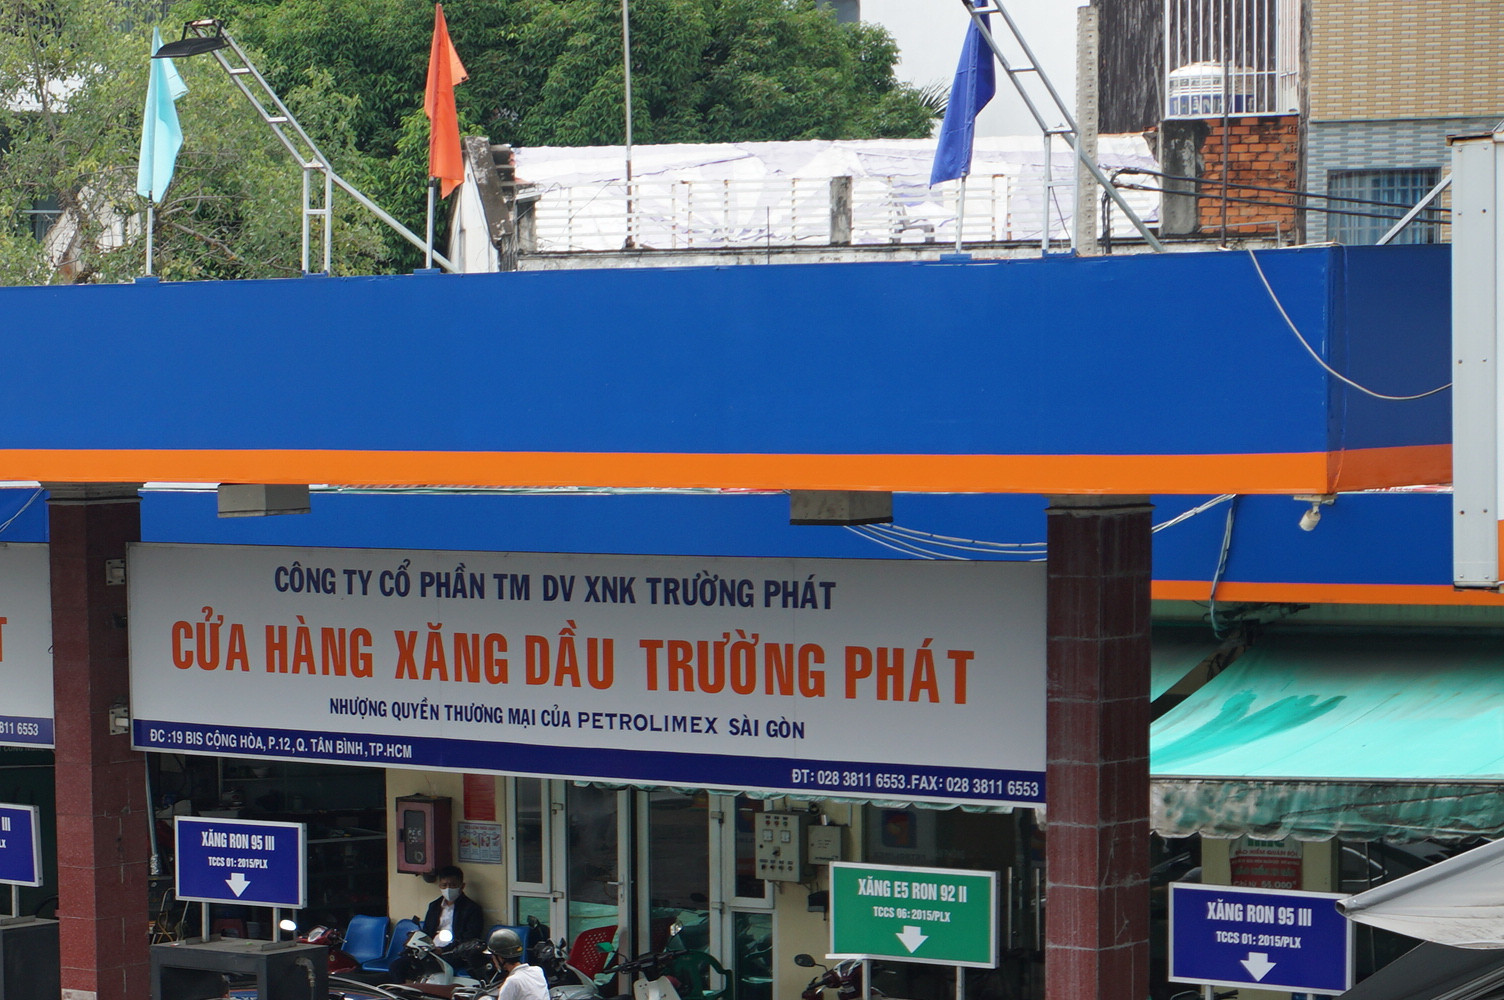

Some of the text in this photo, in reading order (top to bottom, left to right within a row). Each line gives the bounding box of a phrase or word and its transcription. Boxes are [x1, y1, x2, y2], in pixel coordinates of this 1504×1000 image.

[274, 559, 836, 610] CÔNG TY CỔ PHẦN TM DV XNK TRƯỜNG PHÁT
[172, 606, 975, 705] CỬA HÀNG XĂNG DẦU TRƯỜNG PHÁT
[329, 696, 805, 739] NHƯỢNG QUYỀN THƯƠNG MẠI CỦA PETROLIMEX SÀI GÒN
[185, 732, 203, 745] BIS
[206, 730, 237, 750] CỘNG
[310, 736, 333, 753] TÂN
[792, 769, 814, 783] ĐT:
[817, 771, 839, 785] 028
[842, 772, 871, 787] 3811
[946, 778, 969, 792] 028
[973, 779, 1003, 794] 3811
[1007, 781, 1039, 797] 6553
[1, 816, 11, 832] III
[201, 828, 275, 851] XĂNG RON 95 III
[858, 876, 967, 903] XĂNG E5 RON 92 II
[873, 906, 895, 918] TCCS
[911, 909, 951, 922] 2015/PLX
[1207, 898, 1312, 927] XĂNG RON 95 III
[1216, 931, 1302, 949] TCCS 01: 2015/PLX
